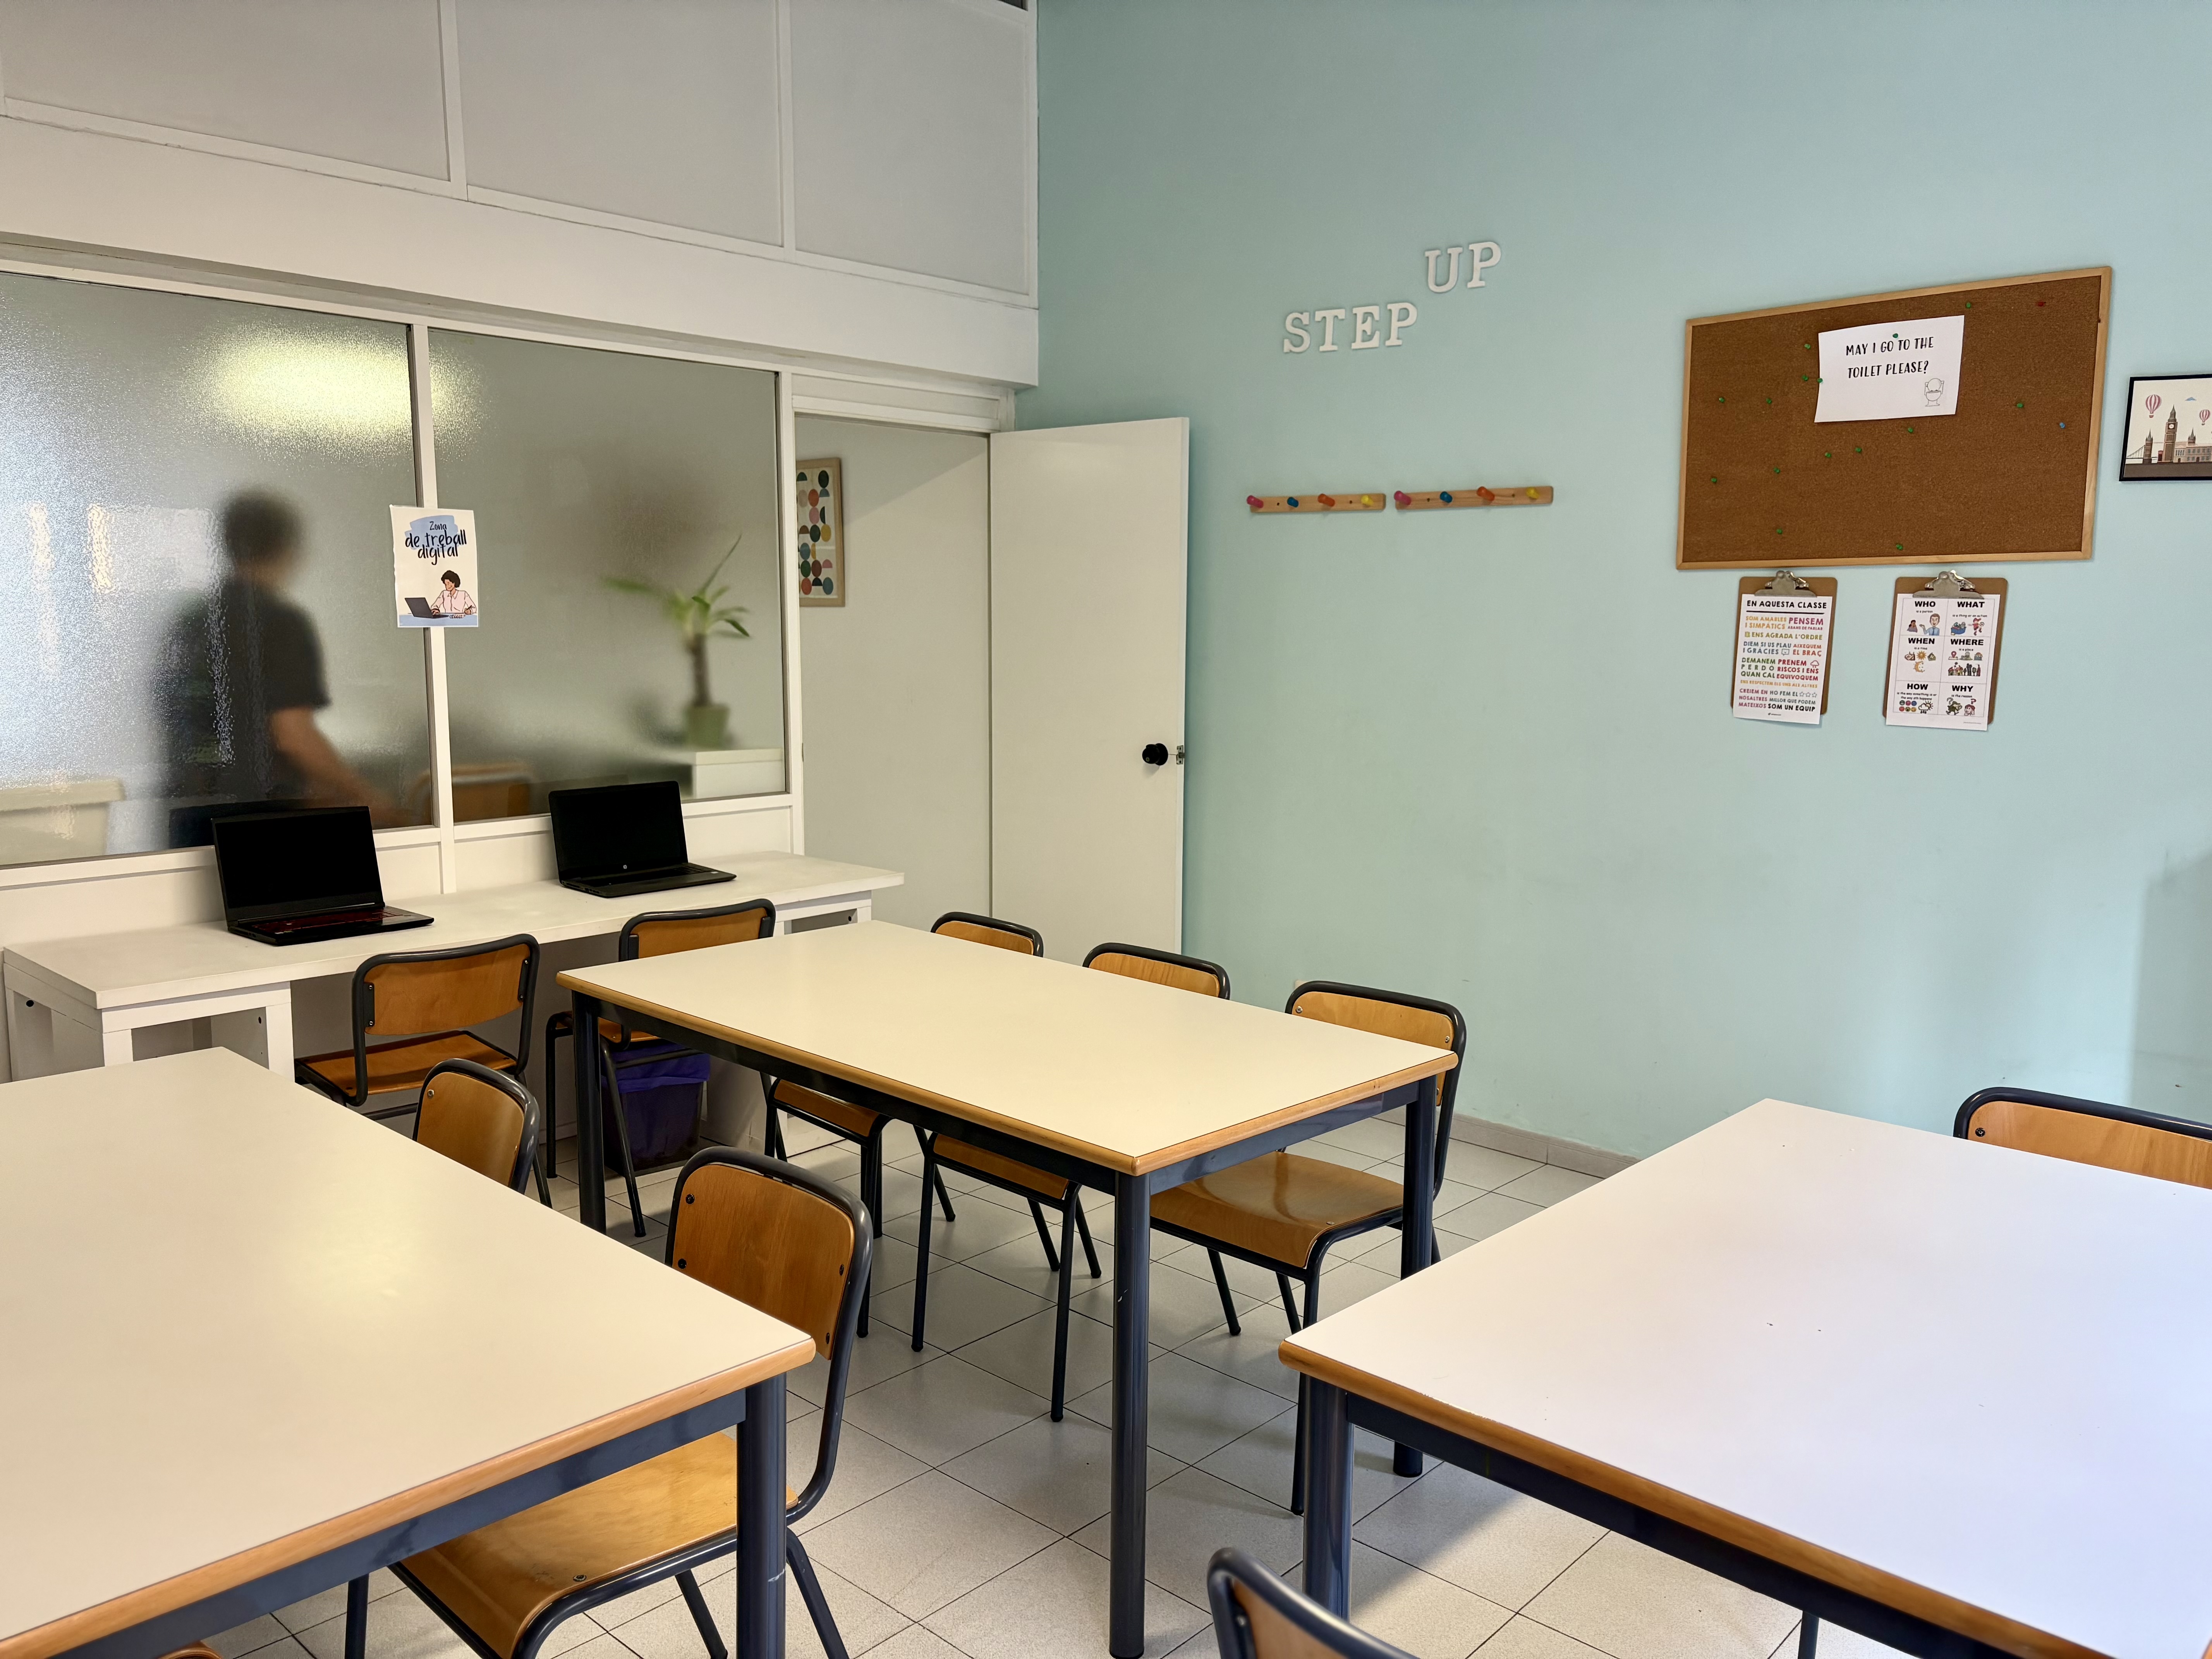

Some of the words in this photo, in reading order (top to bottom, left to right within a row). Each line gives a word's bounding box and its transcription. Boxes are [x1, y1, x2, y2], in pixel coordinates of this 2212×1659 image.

[1283, 302, 1417, 353] STEP
[1425, 242, 1501, 293] UP
[1846, 343, 1868, 356] MAY
[1872, 343, 1875, 353] I
[1881, 341, 1893, 353] GO
[1898, 339, 1910, 351] TO
[1915, 337, 1934, 349] THE
[1848, 365, 1882, 378] TOILET
[1886, 361, 1929, 375] PLEASE?
[429, 521, 447, 530] Zona
[405, 533, 419, 548] de
[425, 529, 467, 547] treball
[418, 544, 458, 565] digital
